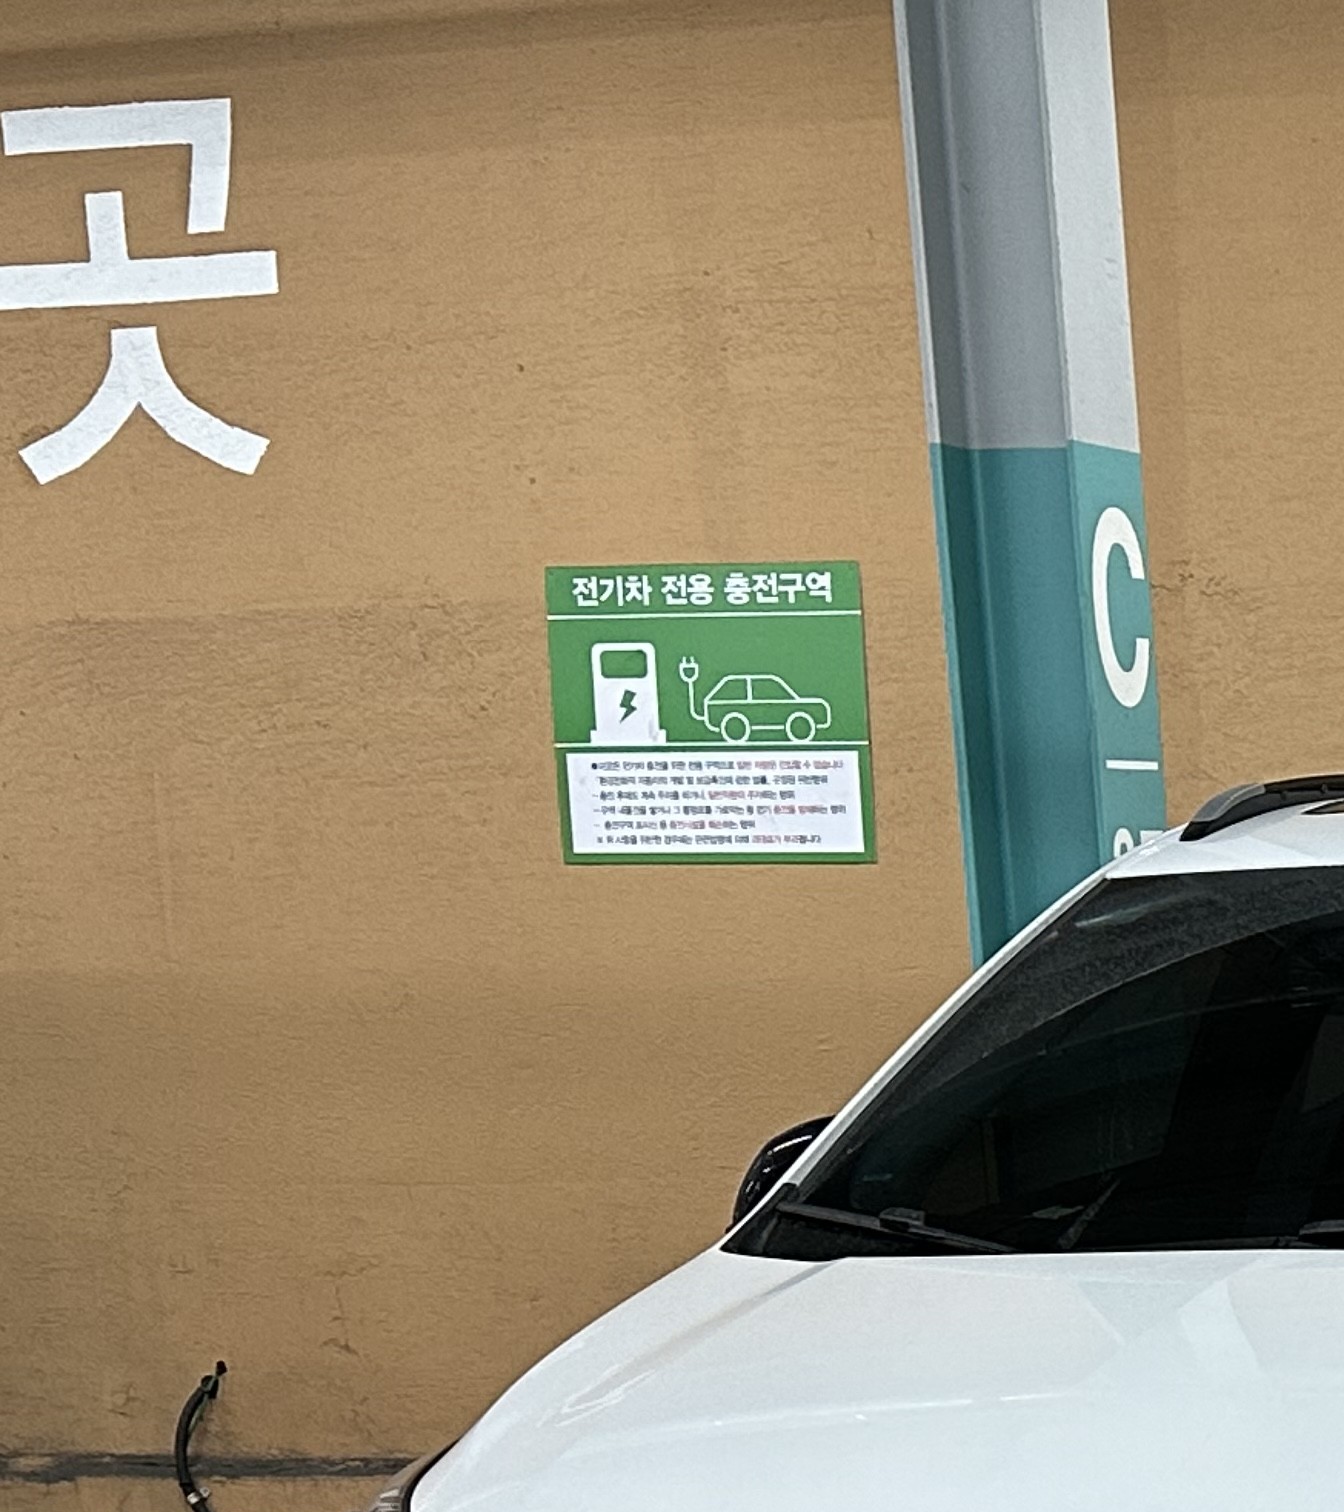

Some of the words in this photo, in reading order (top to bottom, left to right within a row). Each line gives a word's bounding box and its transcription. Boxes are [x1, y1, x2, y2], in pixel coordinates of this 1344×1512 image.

[0, 97, 279, 485] 곳
[571, 574, 653, 607] 전기차
[660, 573, 715, 606] 전용
[723, 571, 833, 605] 충전구역
